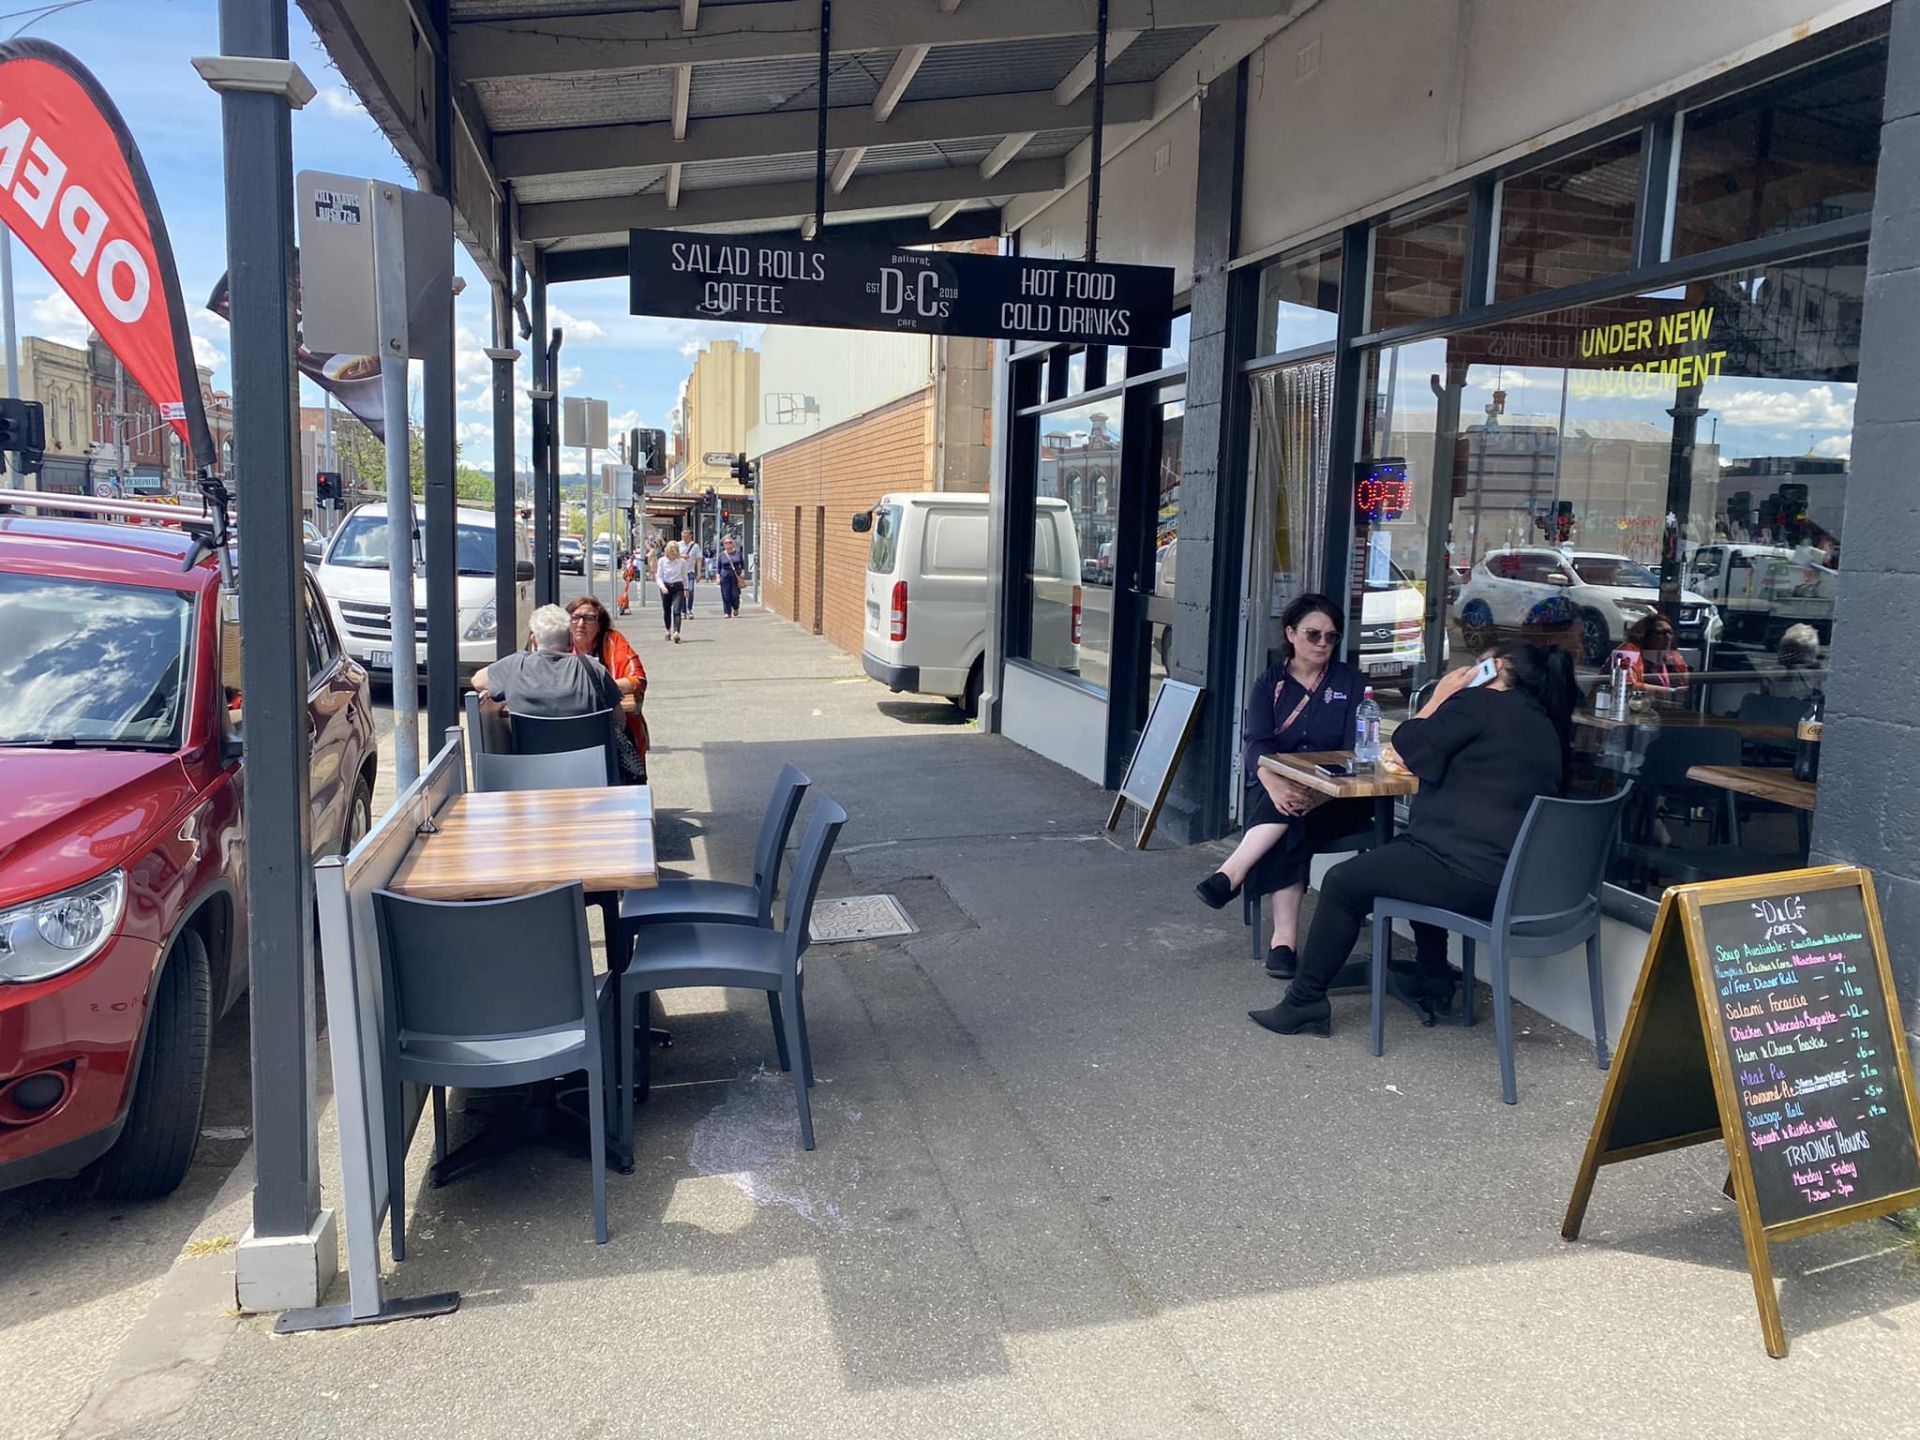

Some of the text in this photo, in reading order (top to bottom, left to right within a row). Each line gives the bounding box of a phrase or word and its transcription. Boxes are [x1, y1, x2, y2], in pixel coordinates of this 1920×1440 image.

[672, 243, 825, 281] SALAD ROLLS
[891, 254, 931, 266] Ballarat
[704, 281, 783, 314] COFFEE
[865, 282, 880, 293] EST
[939, 287, 959, 299] 2018
[1021, 268, 1116, 300] HOT FOOD
[1001, 302, 1130, 336] COLD DRINKS
[1581, 319, 1653, 358] UNDER
[1658, 307, 1714, 347] NEW
[1571, 351, 1727, 397] MANAGEMENT
[1358, 480, 1413, 510] OPEN
[1773, 923, 1793, 936] CAFE
[1715, 944, 1741, 964] Soup
[1721, 982, 1733, 996] w/
[1734, 980, 1751, 993] Free
[1779, 973, 1799, 986] Roll
[1726, 1000, 1764, 1020] Salami
[1768, 992, 1808, 1012] Focaccia
[1730, 1026, 1764, 1042] Chicken
[1774, 1016, 1805, 1034] Avocado
[1803, 1010, 1839, 1032] Baguette
[1736, 1047, 1759, 1063] Ham
[1767, 1041, 1796, 1058] Cheese
[1793, 1034, 1828, 1052] Toastie
[1740, 1068, 1765, 1087] Meat
[1769, 1063, 1786, 1079] Pie
[1743, 1086, 1782, 1106] Flavoured
[1781, 1080, 1798, 1097] Pie
[1747, 1111, 1783, 1130] Sausage
[1785, 1102, 1804, 1118] Roll
[1787, 1120, 1816, 1139] Ricotta
[1783, 1135, 1836, 1167] TRADING
[1792, 1168, 1824, 1187] Monday
[1831, 1160, 1858, 1178] Friday
[1838, 1180, 1855, 1198] 3pm
